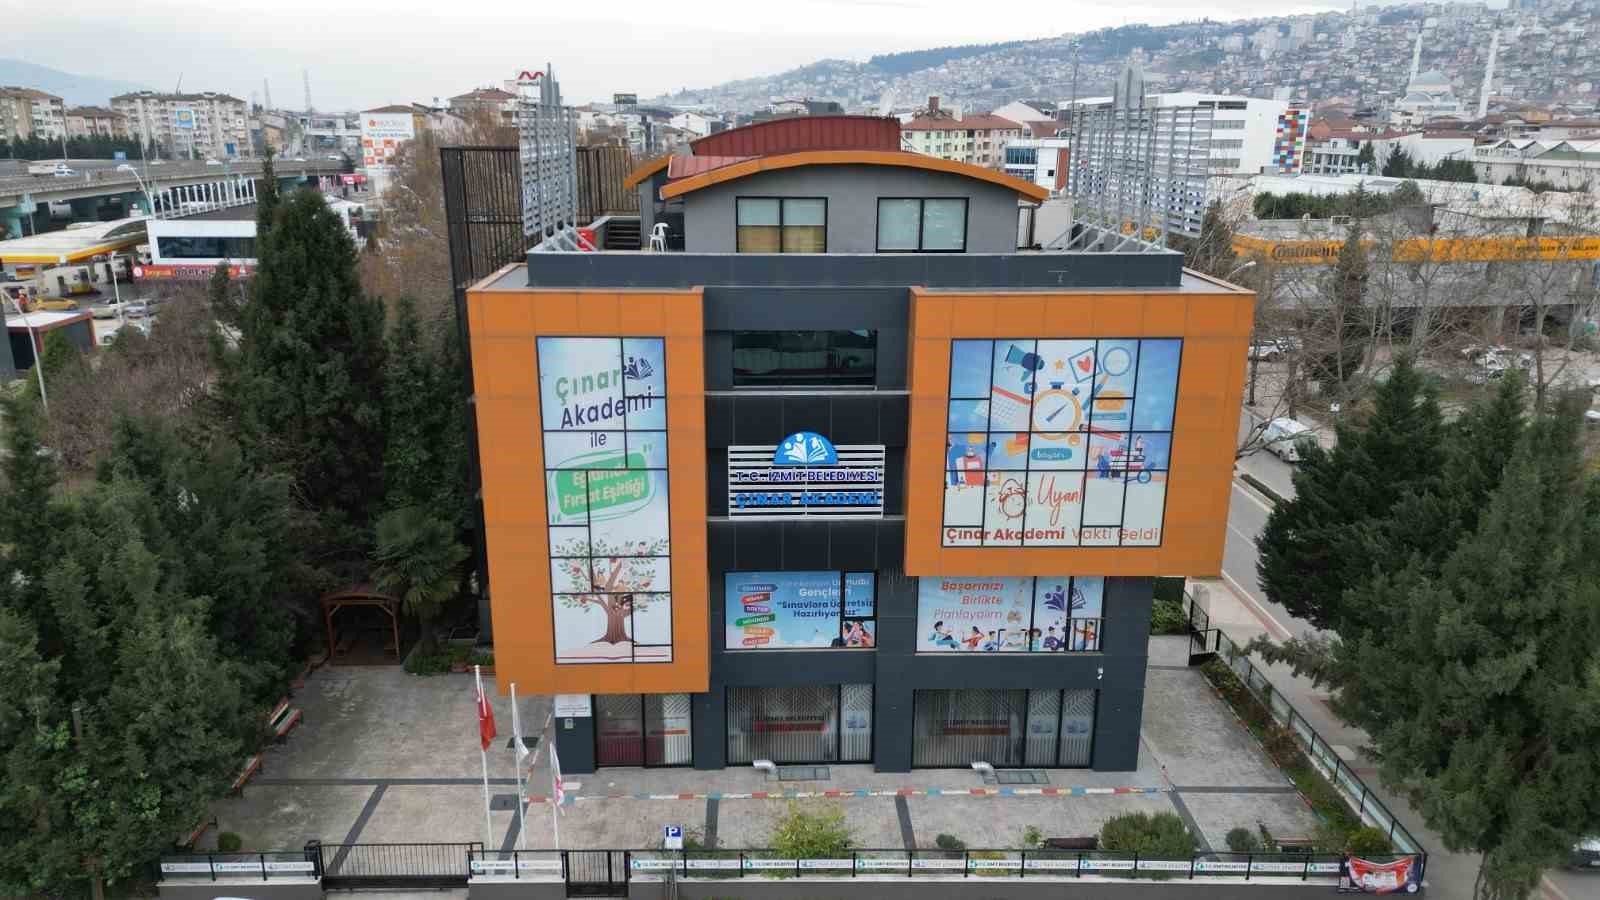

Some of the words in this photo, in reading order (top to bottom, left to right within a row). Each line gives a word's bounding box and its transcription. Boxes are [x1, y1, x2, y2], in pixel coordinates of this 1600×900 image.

[555, 368, 620, 406] Çınar
[560, 385, 652, 429] Akademi
[590, 431, 607, 448] ile
[768, 467, 806, 482] İZMİT
[807, 467, 879, 482] BELEDİYESİ
[735, 492, 792, 510] ÇINAR
[799, 491, 880, 505] AKADEMİ
[946, 528, 991, 544] Çınar
[993, 527, 1065, 540] Akademi
[1071, 527, 1112, 540] Vakti
[1117, 527, 1159, 541] Geldi
[960, 595, 1004, 605] Birlikte
[668, 827, 679, 837] P
